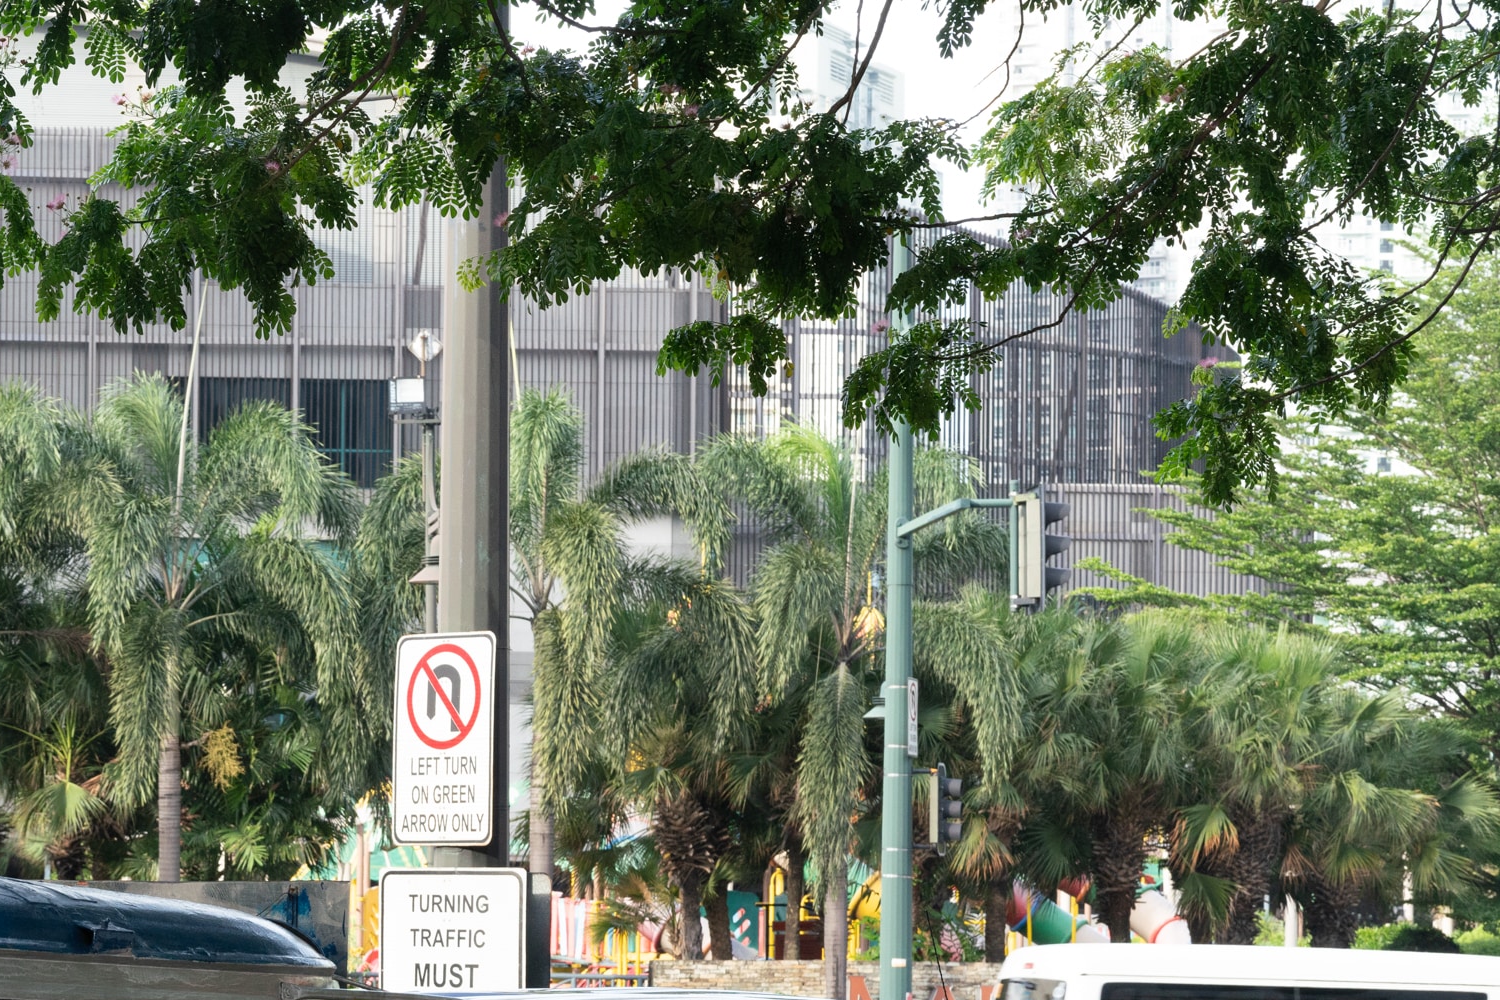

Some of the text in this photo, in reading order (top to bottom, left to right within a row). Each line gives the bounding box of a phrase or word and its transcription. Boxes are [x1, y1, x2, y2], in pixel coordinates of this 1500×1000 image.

[410, 756, 477, 776] LEFT TURN
[411, 784, 476, 804] ON GREEN
[401, 812, 485, 833] ARROW ONLY
[408, 894, 490, 914] TURNING
[410, 928, 487, 948] TRAFFIC
[413, 963, 480, 989] MUST
